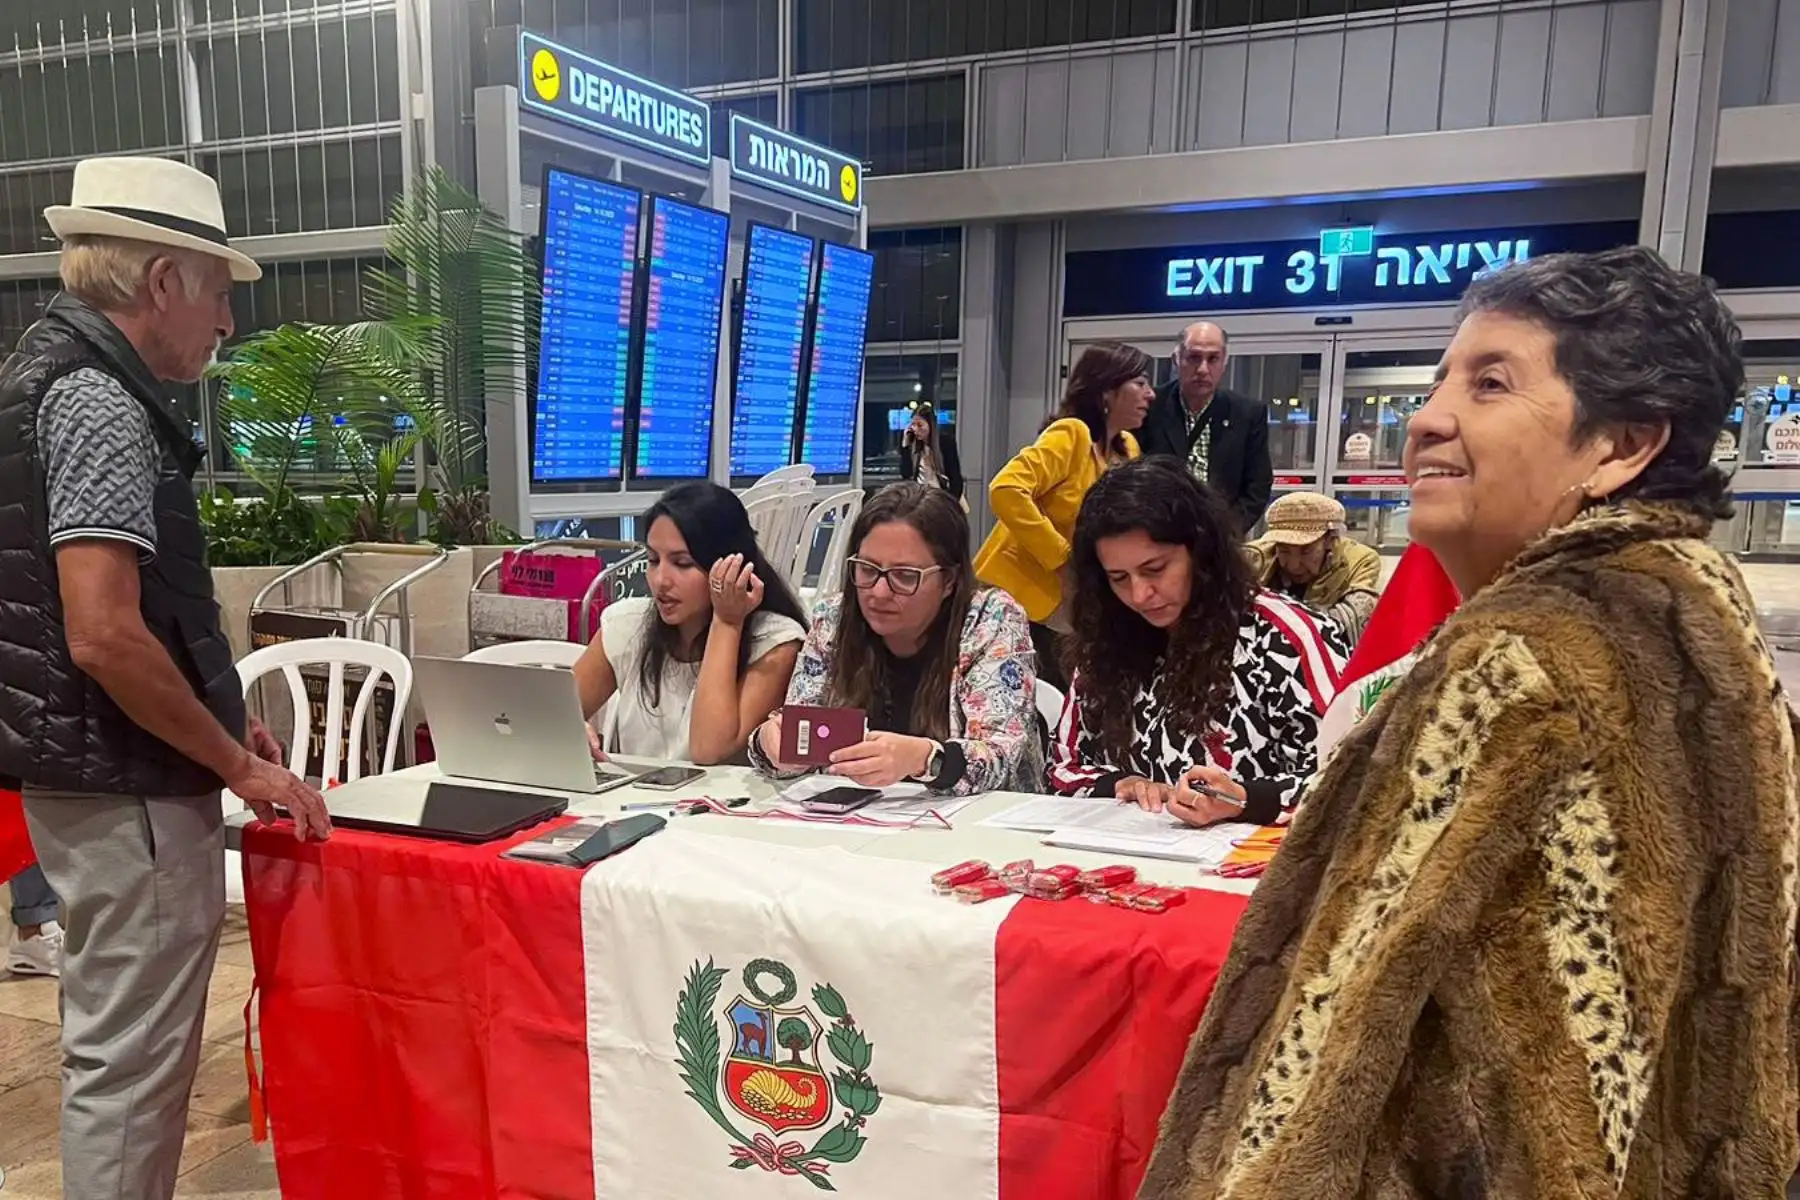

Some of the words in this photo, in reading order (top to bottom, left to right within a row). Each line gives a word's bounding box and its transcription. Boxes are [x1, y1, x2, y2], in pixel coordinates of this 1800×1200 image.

[569, 66, 703, 148] DEPARTURES
[748, 133, 830, 190] המראות
[1166, 256, 1265, 296] EXIT
[1285, 250, 1341, 293] 31
